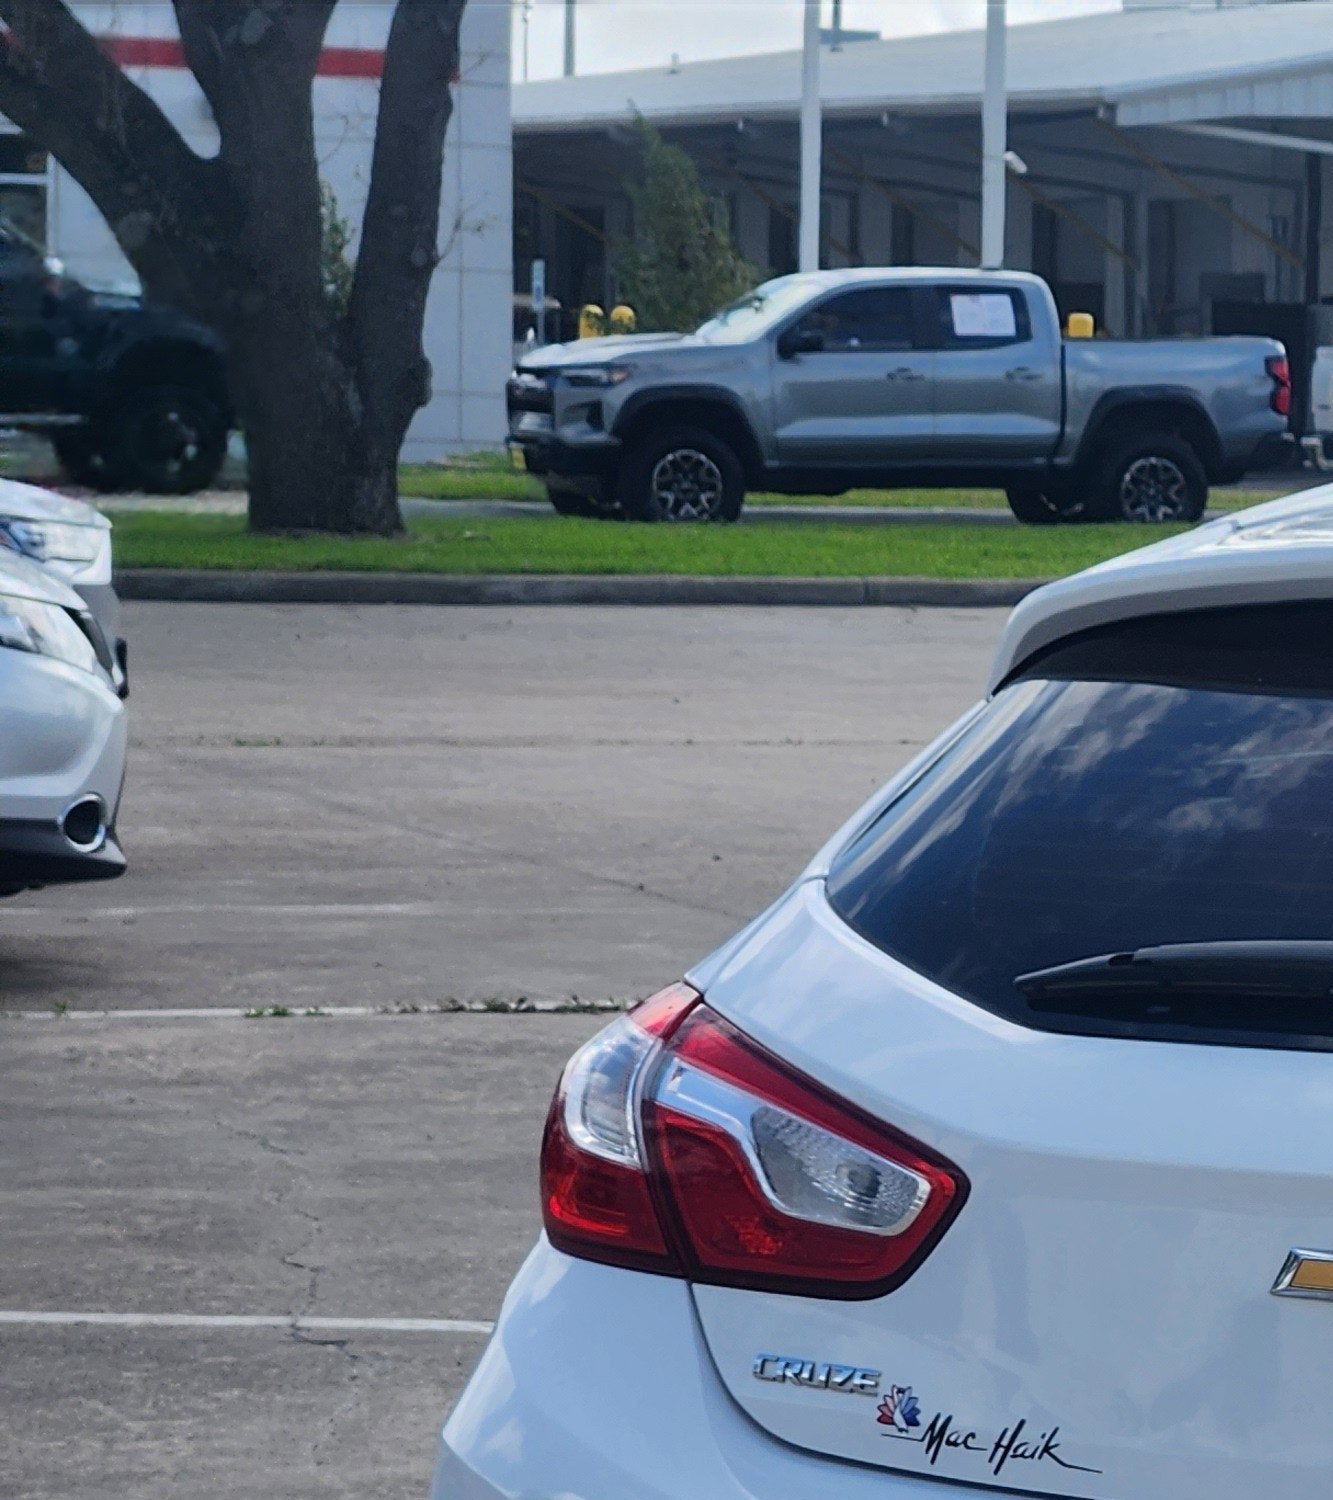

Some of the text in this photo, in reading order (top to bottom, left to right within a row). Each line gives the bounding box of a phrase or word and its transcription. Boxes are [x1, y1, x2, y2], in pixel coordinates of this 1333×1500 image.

[752, 1353, 882, 1396] CRUZE
[918, 1412, 1103, 1475] Mac Haik
